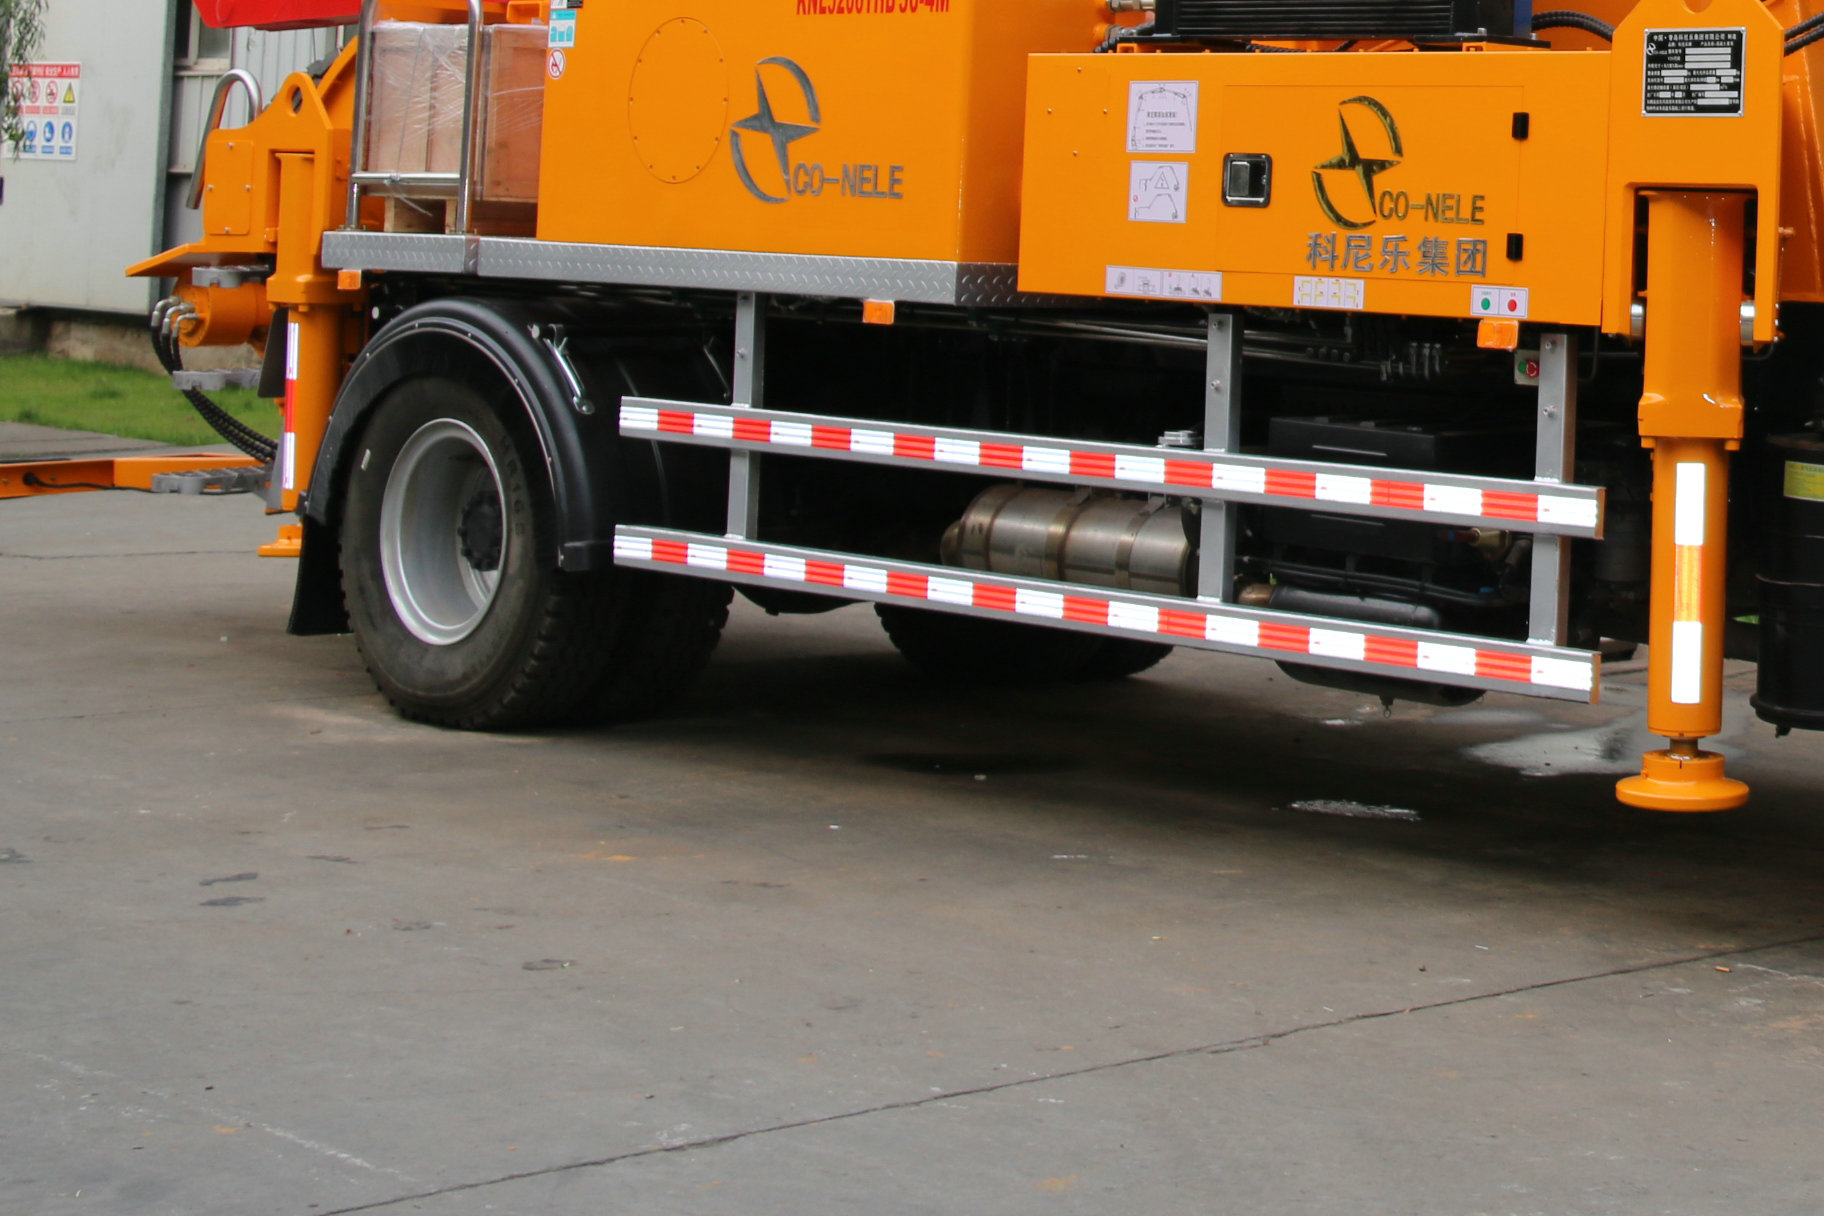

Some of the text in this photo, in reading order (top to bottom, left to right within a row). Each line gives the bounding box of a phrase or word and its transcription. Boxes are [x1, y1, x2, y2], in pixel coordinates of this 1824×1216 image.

[794, 162, 904, 200] CO-NELE
[1379, 190, 1485, 225] CO-NELE
[1306, 231, 1488, 277] 科尼乐集团
